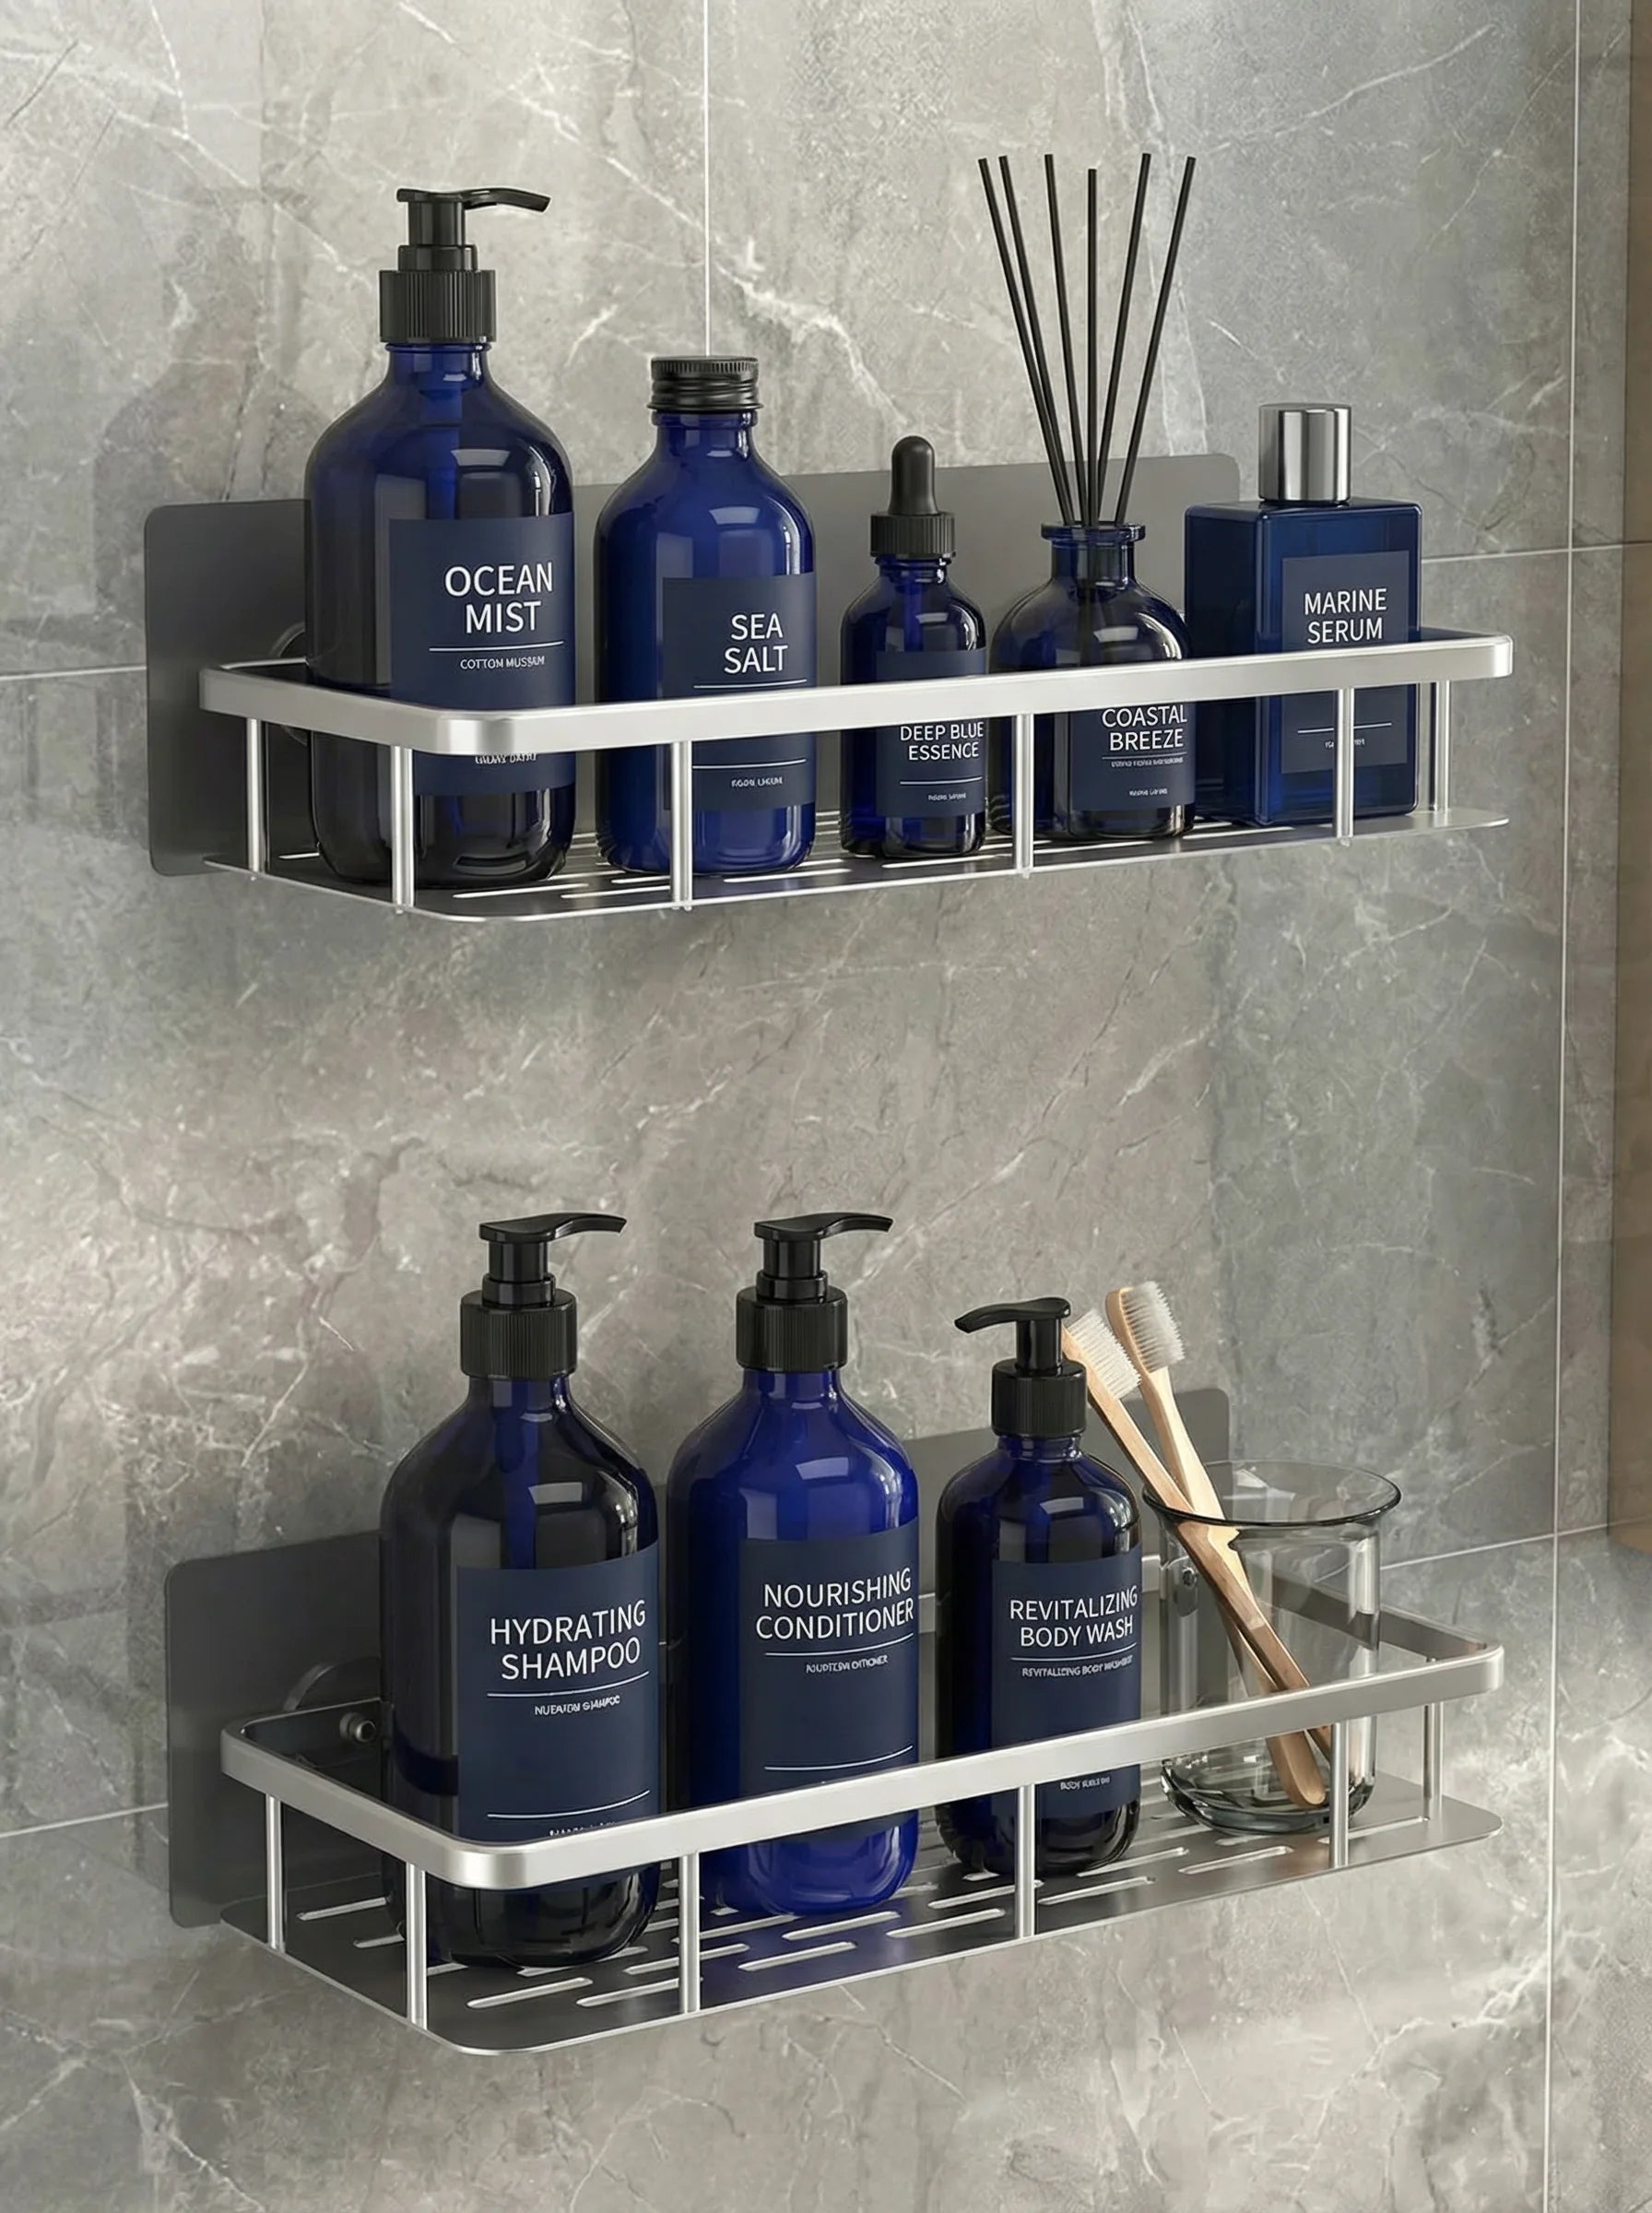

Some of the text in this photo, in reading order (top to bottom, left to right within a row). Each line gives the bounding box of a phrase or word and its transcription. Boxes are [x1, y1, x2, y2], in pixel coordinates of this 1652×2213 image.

[444, 562, 553, 598] OCEAN
[466, 599, 542, 634] MIST
[1304, 588, 1387, 616] MARINE
[730, 612, 785, 641] SEA
[1307, 617, 1383, 645] SERUM
[460, 657, 503, 669] COTTON
[724, 645, 788, 675] SALT
[900, 721, 985, 741] DEEP BLUE
[1102, 704, 1188, 728] COASTAL
[908, 741, 980, 761] ESSENCE
[1109, 728, 1185, 751] BREEZE
[763, 1567, 912, 1609] NOURISHING
[1009, 1585, 1139, 1621] REVITALIZING
[490, 1599, 646, 1646] HYDRATING
[755, 1597, 914, 1640] CONDITIONER
[1020, 1614, 1134, 1648] BODY WASH
[501, 1636, 641, 1681] SHAMPOO
